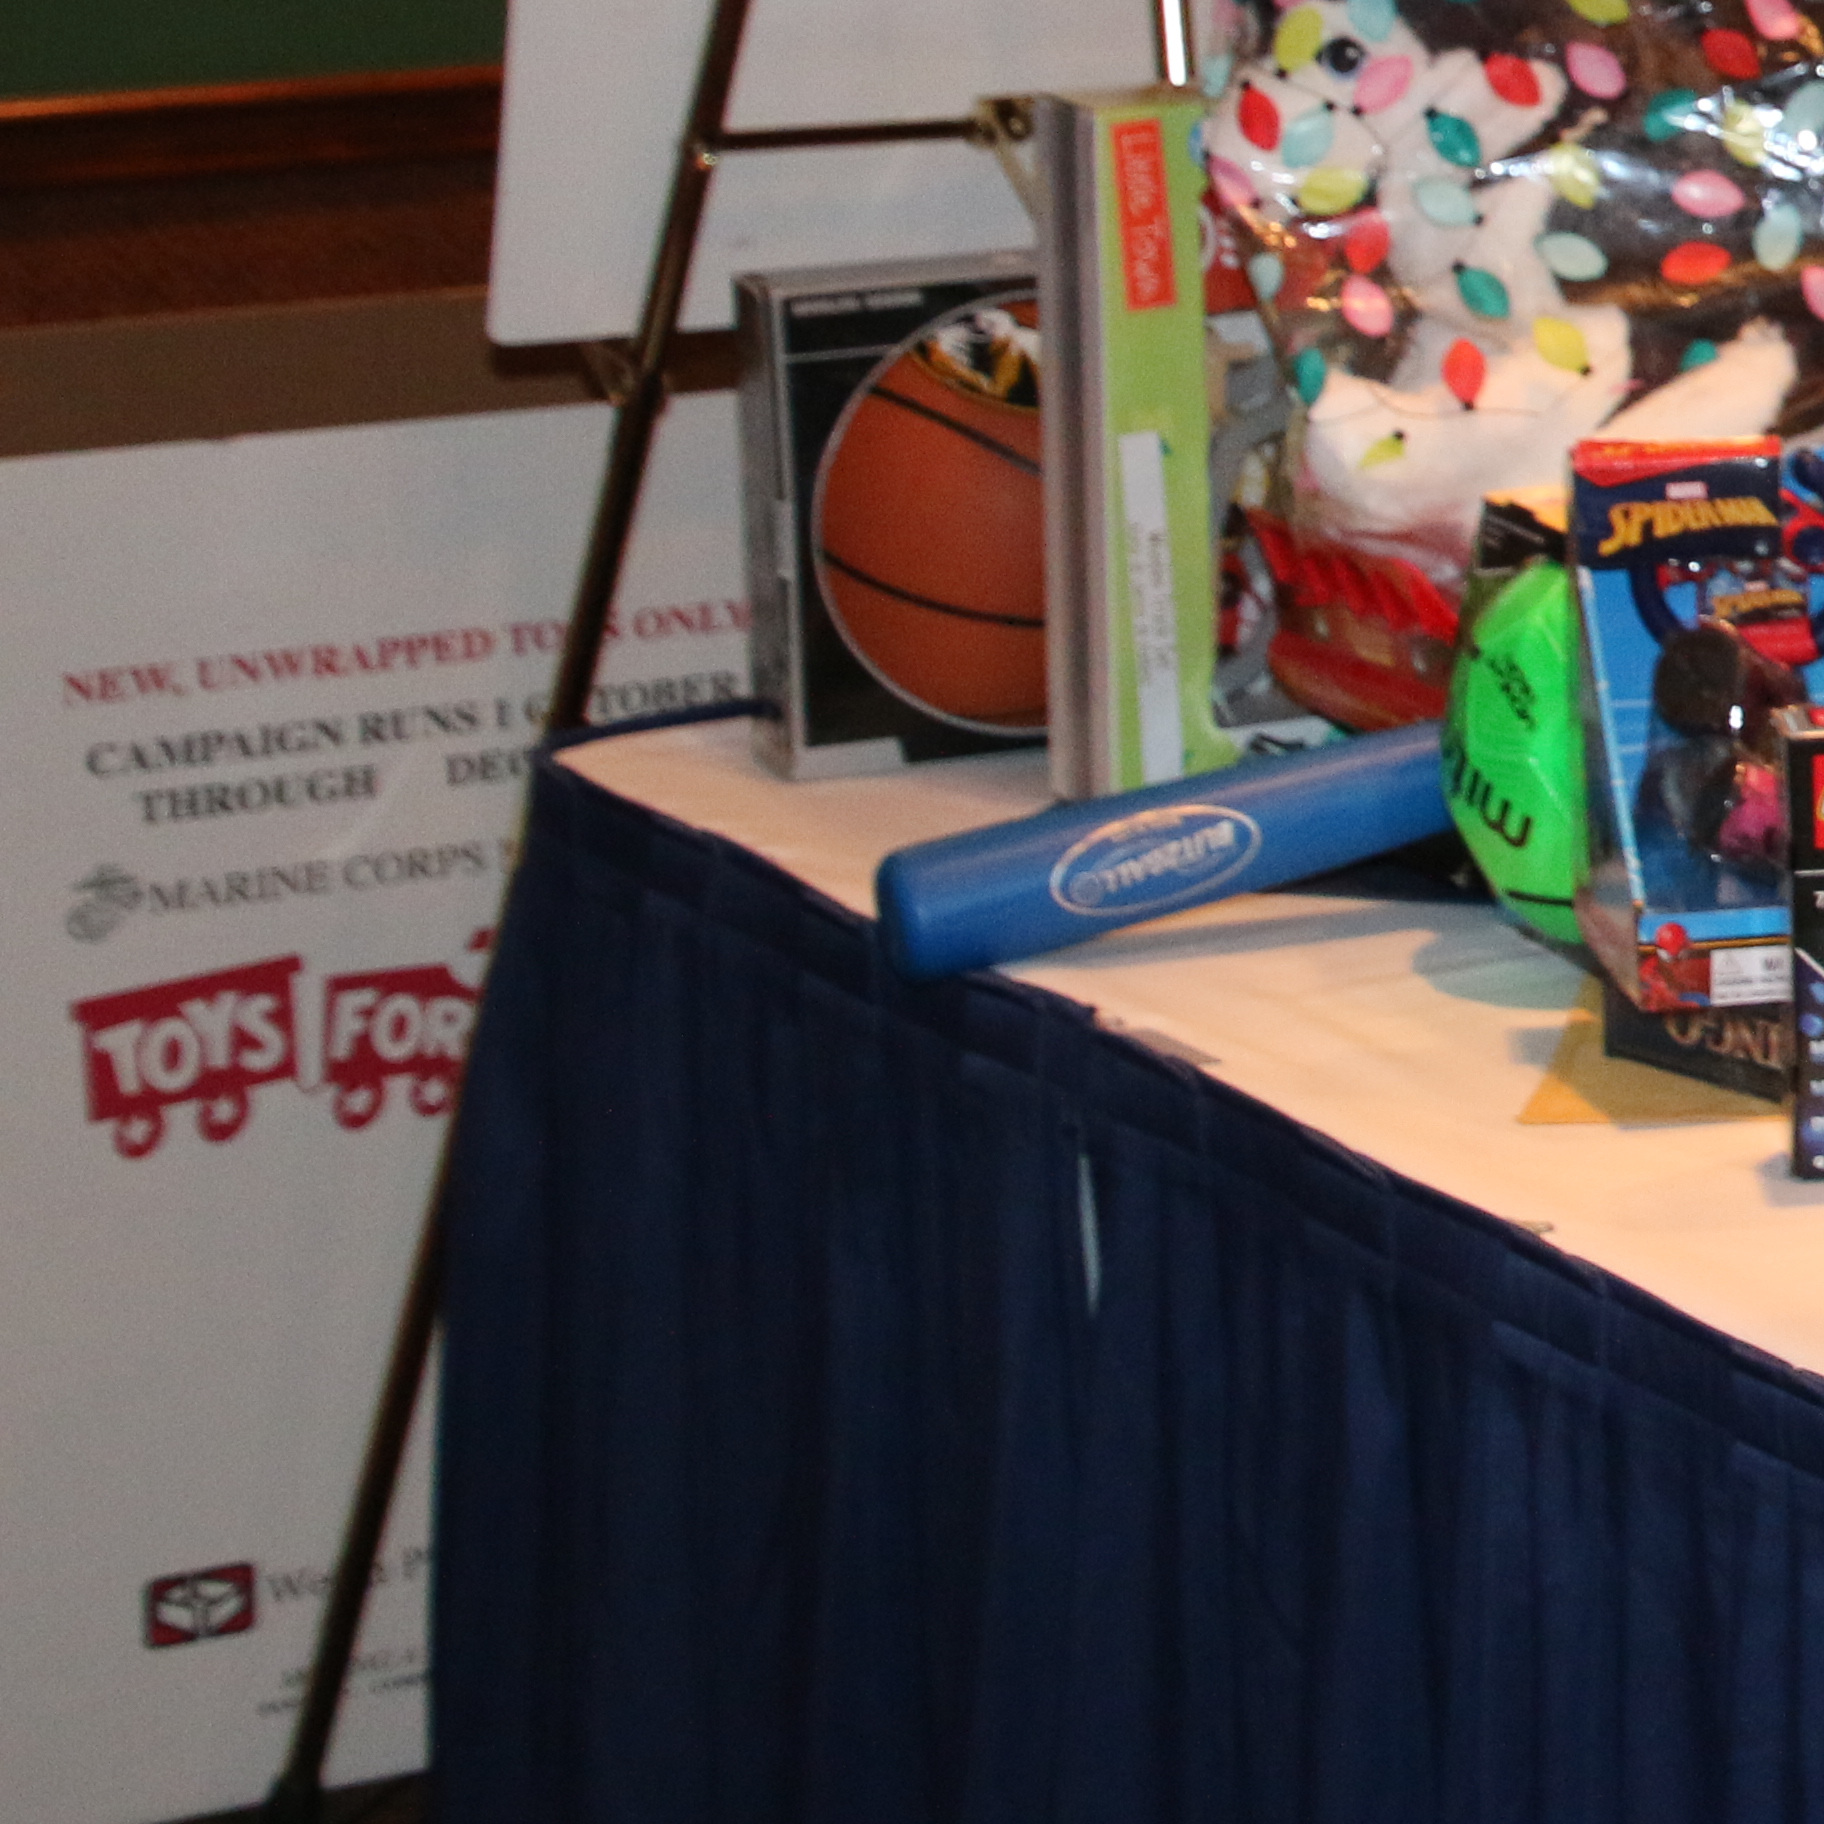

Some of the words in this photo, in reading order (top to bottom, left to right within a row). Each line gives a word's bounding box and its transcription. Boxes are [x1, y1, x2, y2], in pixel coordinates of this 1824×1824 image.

[62, 661, 188, 707] NEW,
[195, 625, 498, 692] UNWRAPPED
[84, 716, 345, 779] CAMPAIGN
[356, 697, 481, 747] RUNS
[132, 762, 377, 827] THROUGH
[147, 859, 328, 917] MARINE
[341, 840, 488, 893] CORPS
[95, 989, 288, 1097] TOYS
[327, 987, 472, 1062] FOR
